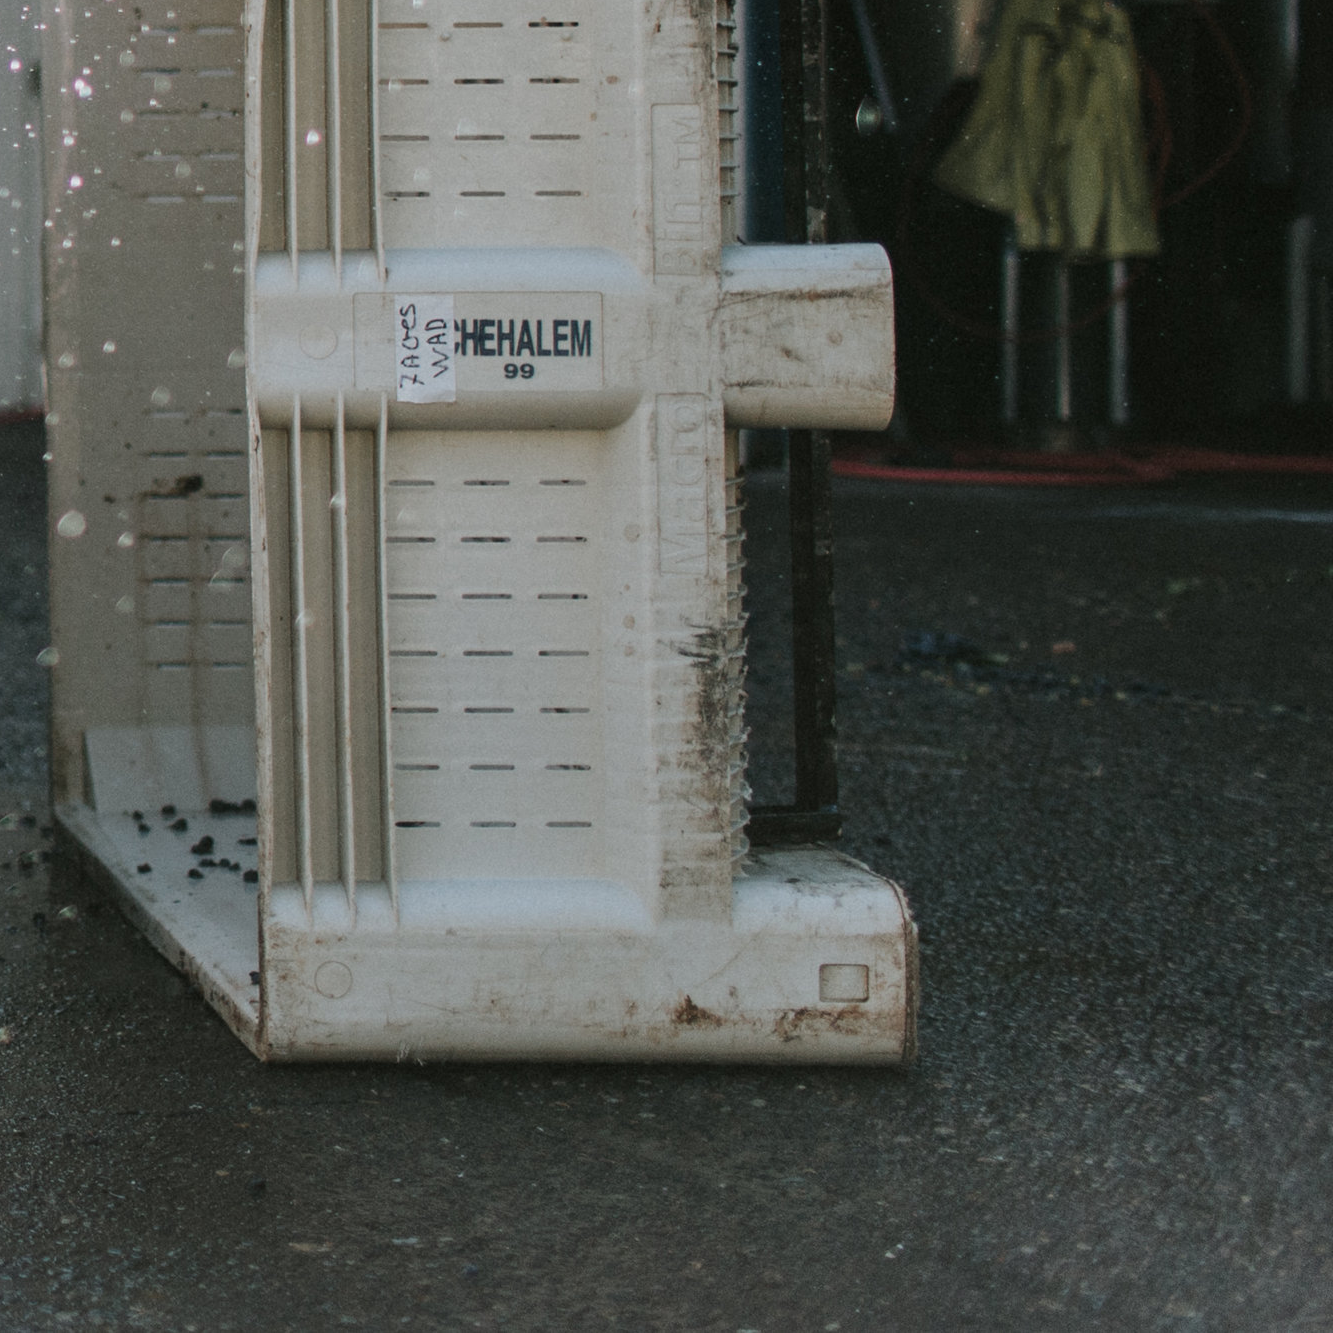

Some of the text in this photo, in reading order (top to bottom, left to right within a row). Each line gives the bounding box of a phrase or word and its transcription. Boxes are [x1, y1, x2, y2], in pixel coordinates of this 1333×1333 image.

[424, 318, 450, 378] WAD
[503, 363, 535, 379] 99
[399, 373, 425, 389] 7
